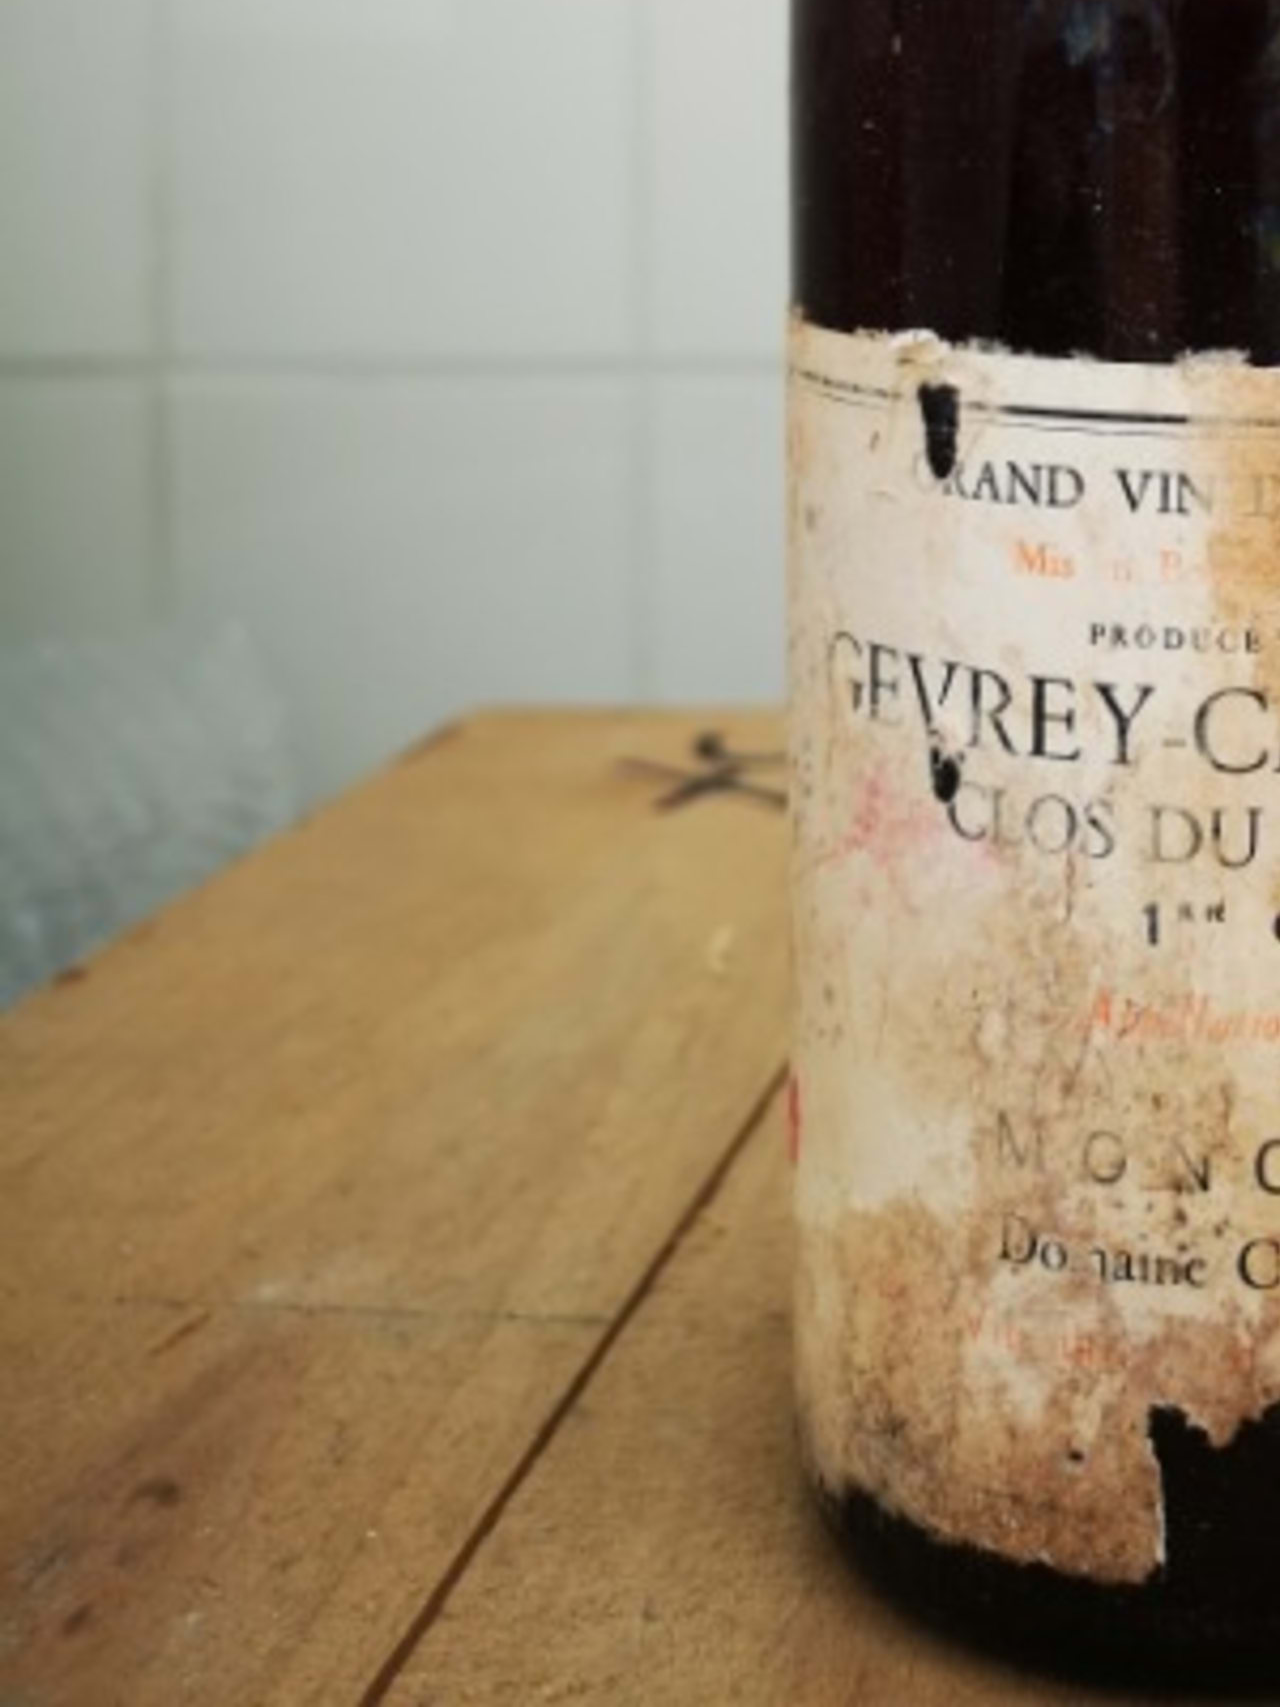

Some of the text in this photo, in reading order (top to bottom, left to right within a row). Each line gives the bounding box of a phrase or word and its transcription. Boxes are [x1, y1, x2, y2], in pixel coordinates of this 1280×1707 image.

[1114, 467, 1213, 516] VIN
[1088, 622, 1261, 655] PRODUCE
[946, 780, 1116, 860] CLOS
[1150, 803, 1263, 869] DU
